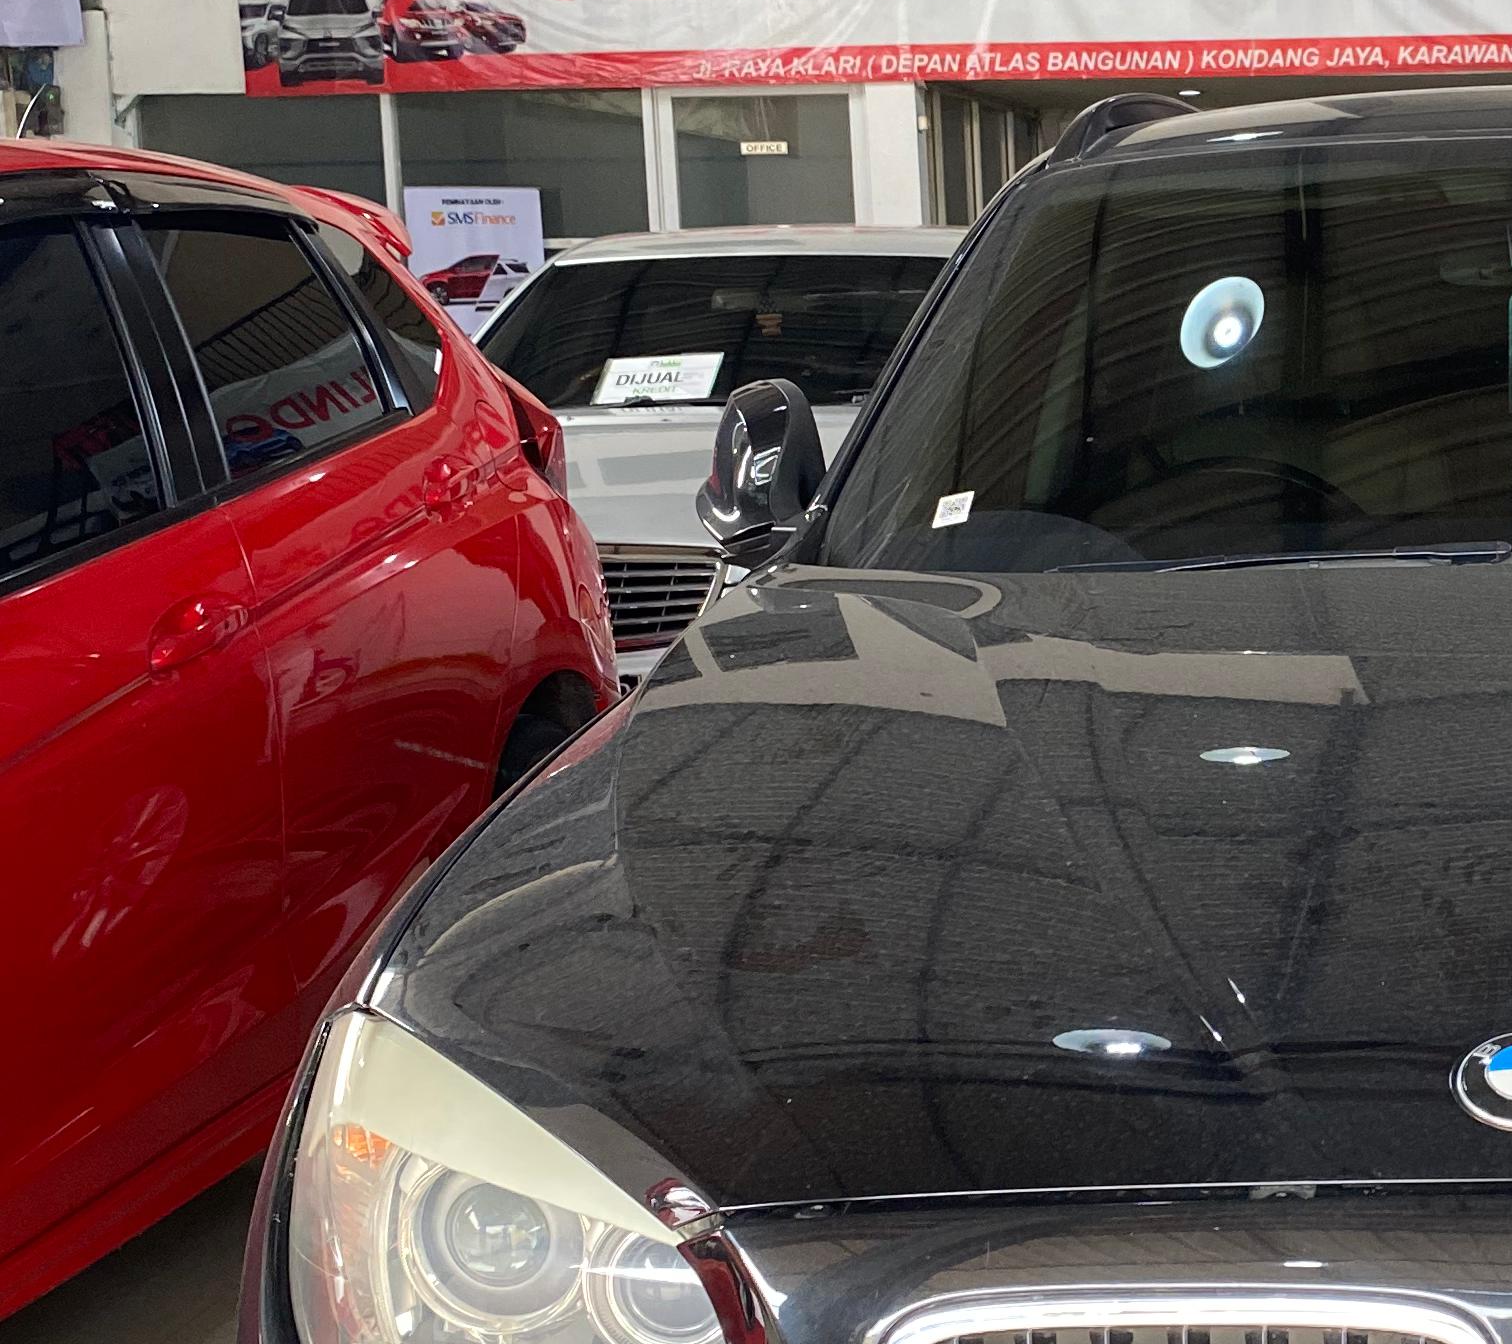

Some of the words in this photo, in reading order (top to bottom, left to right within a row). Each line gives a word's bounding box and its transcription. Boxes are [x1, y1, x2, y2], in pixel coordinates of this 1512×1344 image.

[724, 57, 785, 78] RAYA
[965, 51, 1041, 74] ATLAS
[1200, 47, 1320, 71] KONDANG
[1326, 46, 1390, 69] JAYA,
[616, 371, 684, 386] DIJUAL
